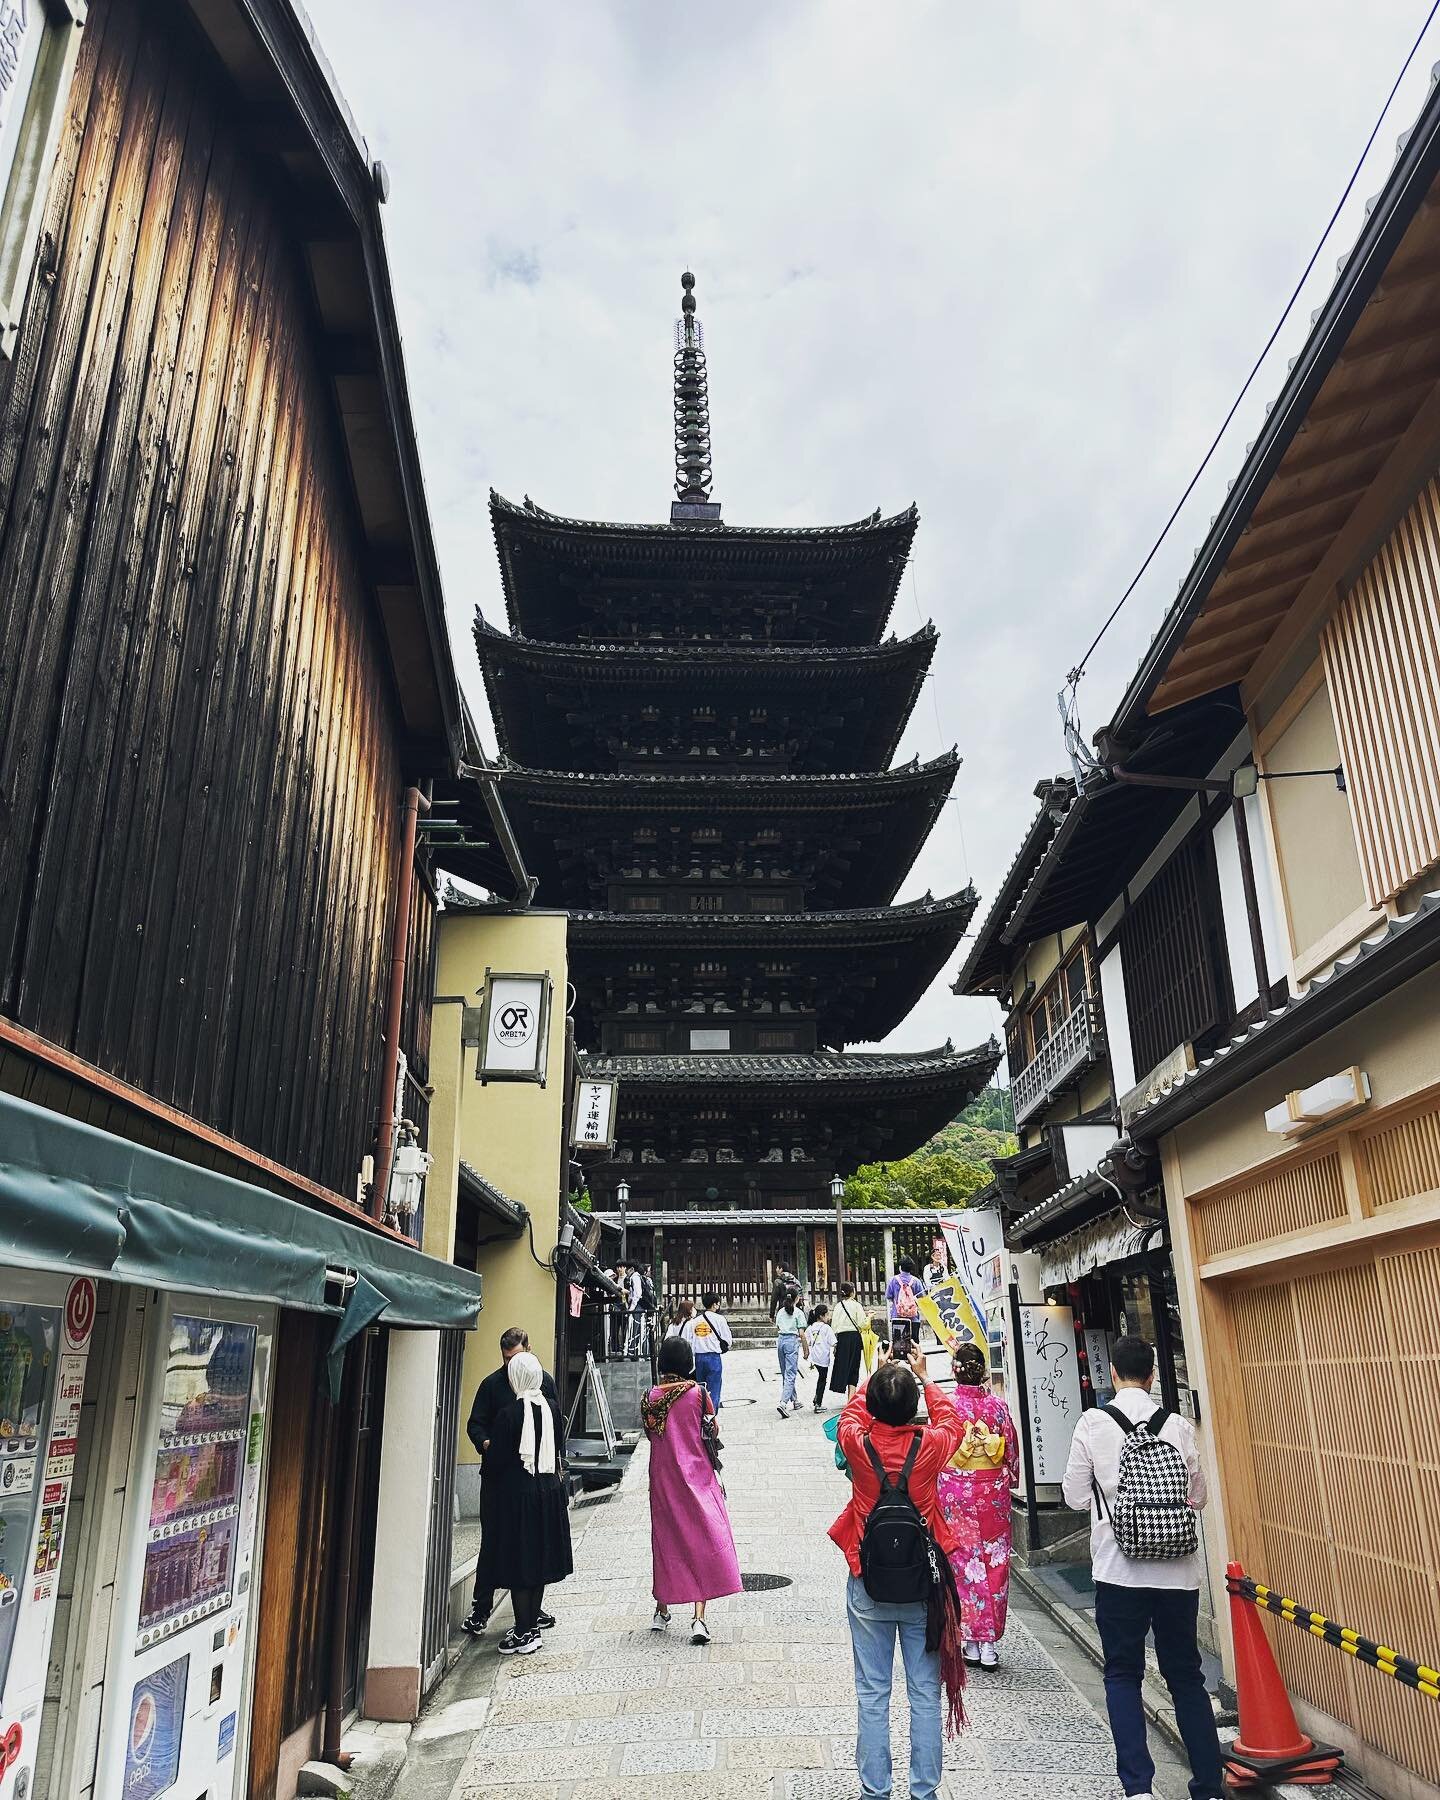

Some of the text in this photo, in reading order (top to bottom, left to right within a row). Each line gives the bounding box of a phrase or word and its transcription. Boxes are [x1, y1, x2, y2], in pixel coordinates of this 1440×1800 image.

[1022, 1309, 1032, 1338] 営業中
[1091, 1334, 1105, 1385] 京の豆菓子
[129, 1759, 152, 1790] pepsi
